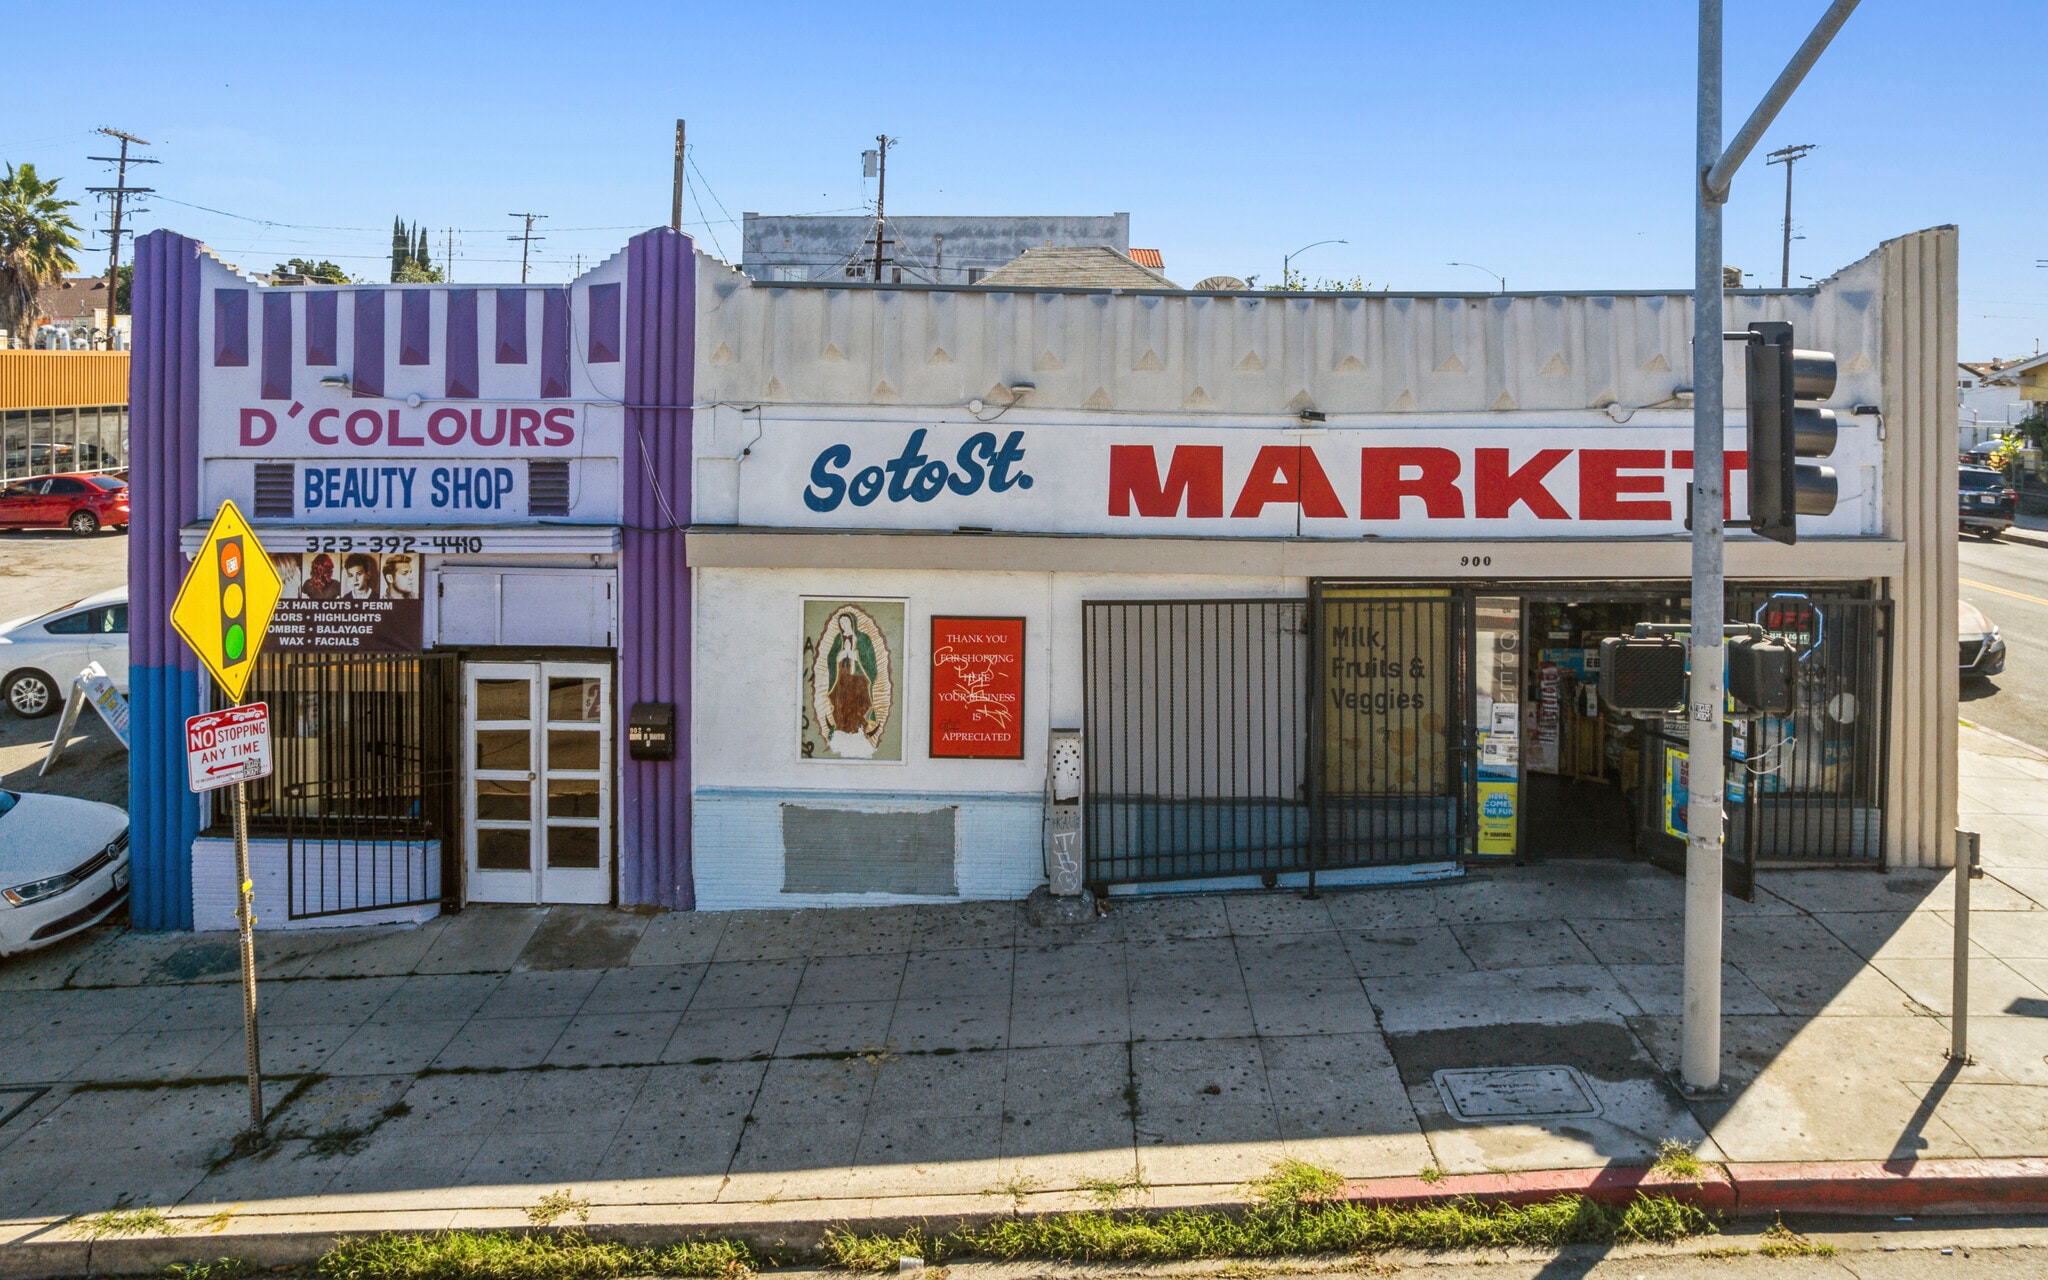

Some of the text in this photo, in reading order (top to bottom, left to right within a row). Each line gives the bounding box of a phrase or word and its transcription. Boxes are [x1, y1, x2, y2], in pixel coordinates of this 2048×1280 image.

[239, 401, 575, 447] D'COLOURS
[304, 466, 513, 509] BEAUTY SHOP
[306, 536, 483, 554] 323-392-4410
[1460, 555, 1493, 568] 900
[292, 601, 319, 610] HAIR
[322, 601, 351, 610] CUTS
[362, 601, 393, 610] PERM
[314, 613, 382, 622] HIGHLIGHTS
[267, 625, 373, 634] OMBRE BALAYAGE
[279, 637, 360, 646] WAX FACIALS
[946, 634, 1008, 643] THANK YOU
[1332, 626, 1386, 651] Milk,
[940, 654, 1014, 663] FOR SHOPPING
[1586, 658, 1601, 668] EB
[1332, 657, 1425, 679] Fruits &
[963, 673, 990, 682] HERE
[938, 693, 1016, 701] YOUR BUSINESS
[1331, 688, 1425, 715] Veggies
[972, 712, 982, 721] IS
[190, 721, 266, 751] NO STOPPING
[942, 732, 1011, 741] APPRECIATED
[201, 741, 260, 764] ANY TIME
[1488, 792, 1508, 800] HERE
[1498, 808, 1514, 816] FUN
